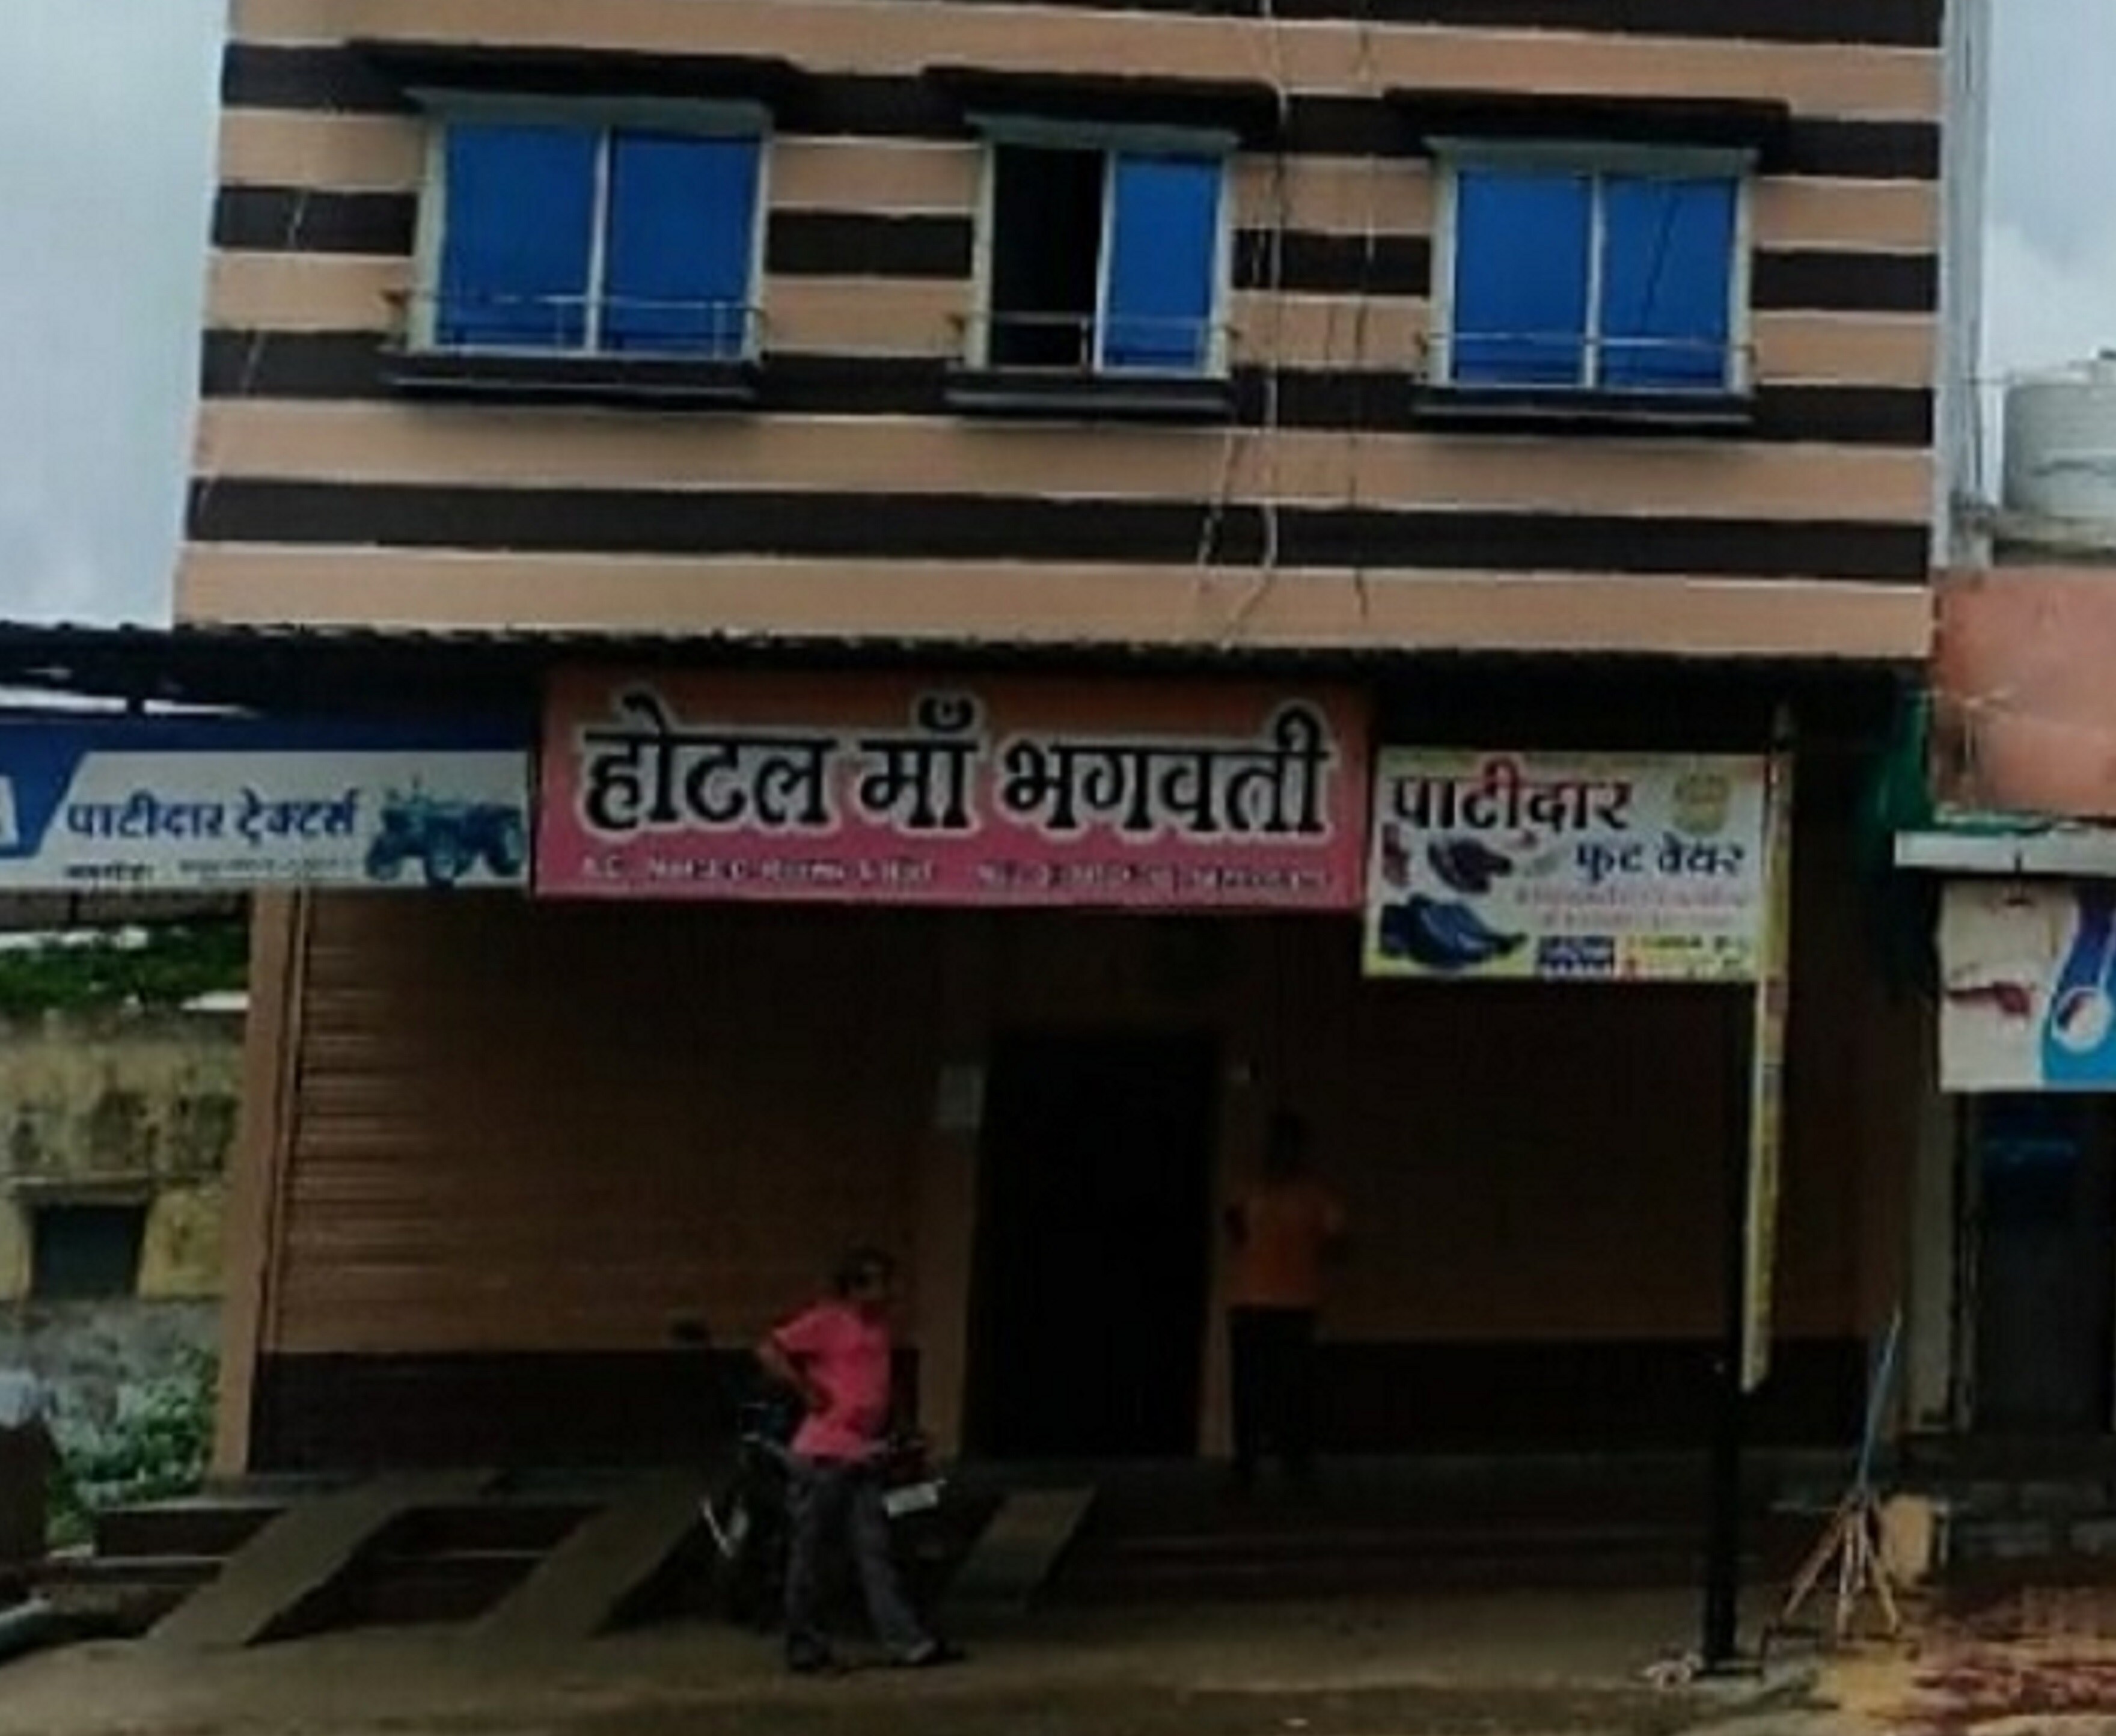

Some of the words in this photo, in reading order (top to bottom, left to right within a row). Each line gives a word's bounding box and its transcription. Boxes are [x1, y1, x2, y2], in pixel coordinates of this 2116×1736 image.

[580, 690, 837, 833] होटल
[858, 697, 979, 831] माँ
[1003, 708, 1330, 834] भगवती
[1392, 757, 1633, 833] पाटीदार
[67, 790, 224, 839] पाटीदार
